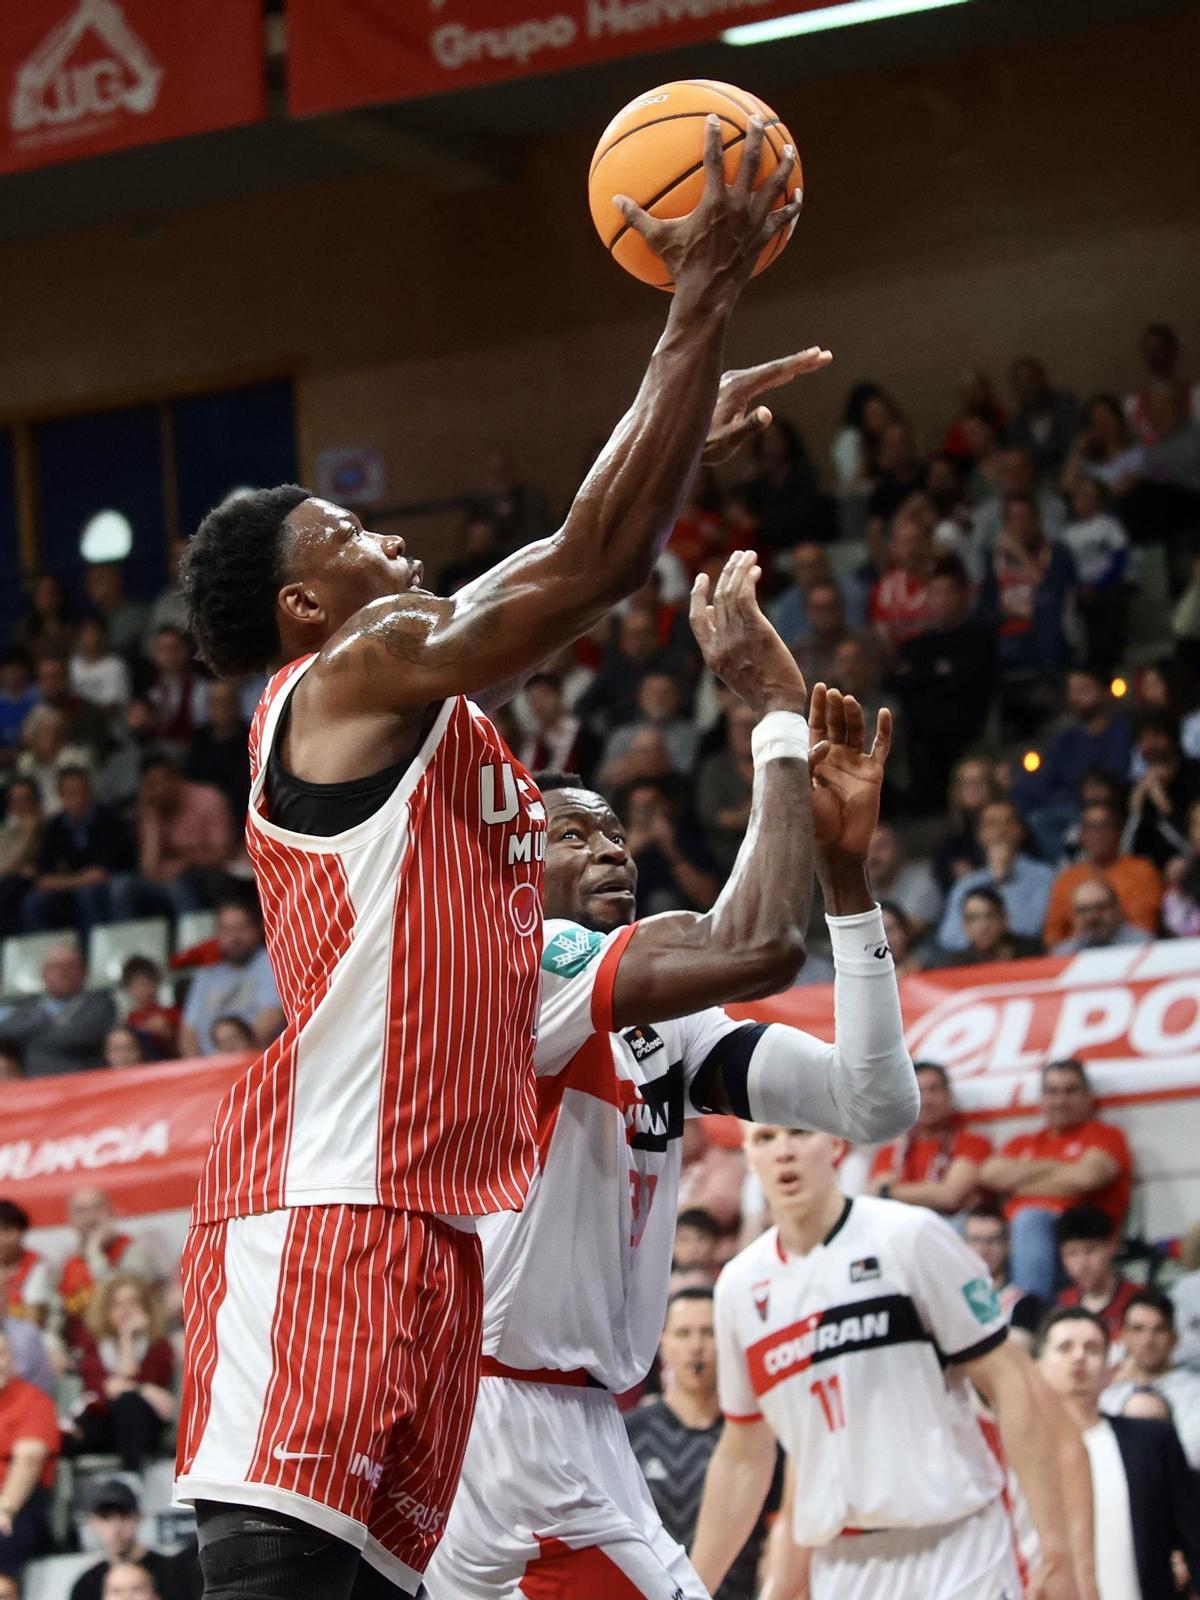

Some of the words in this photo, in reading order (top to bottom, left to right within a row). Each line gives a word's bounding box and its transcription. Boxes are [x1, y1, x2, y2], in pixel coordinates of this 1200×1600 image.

[431, 15, 577, 70] Grupo
[508, 831, 547, 866] MU
[810, 1373, 847, 1433] 11
